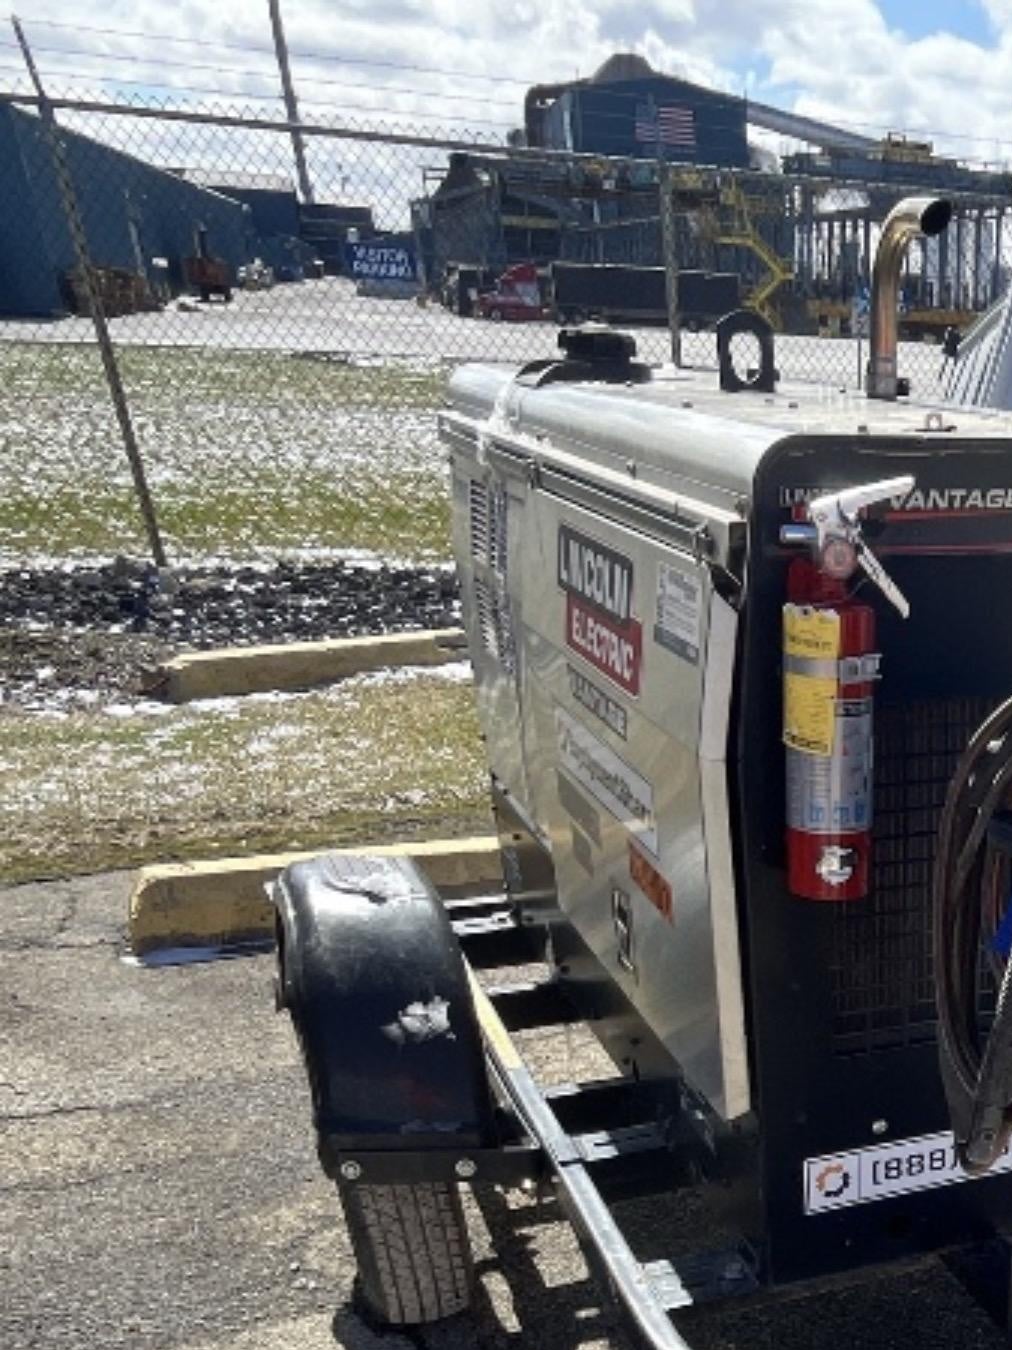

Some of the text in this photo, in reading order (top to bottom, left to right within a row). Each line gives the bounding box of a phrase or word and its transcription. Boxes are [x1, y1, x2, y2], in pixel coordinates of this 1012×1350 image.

[560, 532, 629, 620] LINCOLN
[571, 606, 634, 682] ELECTRIC
[871, 1147, 958, 1186] (888)
